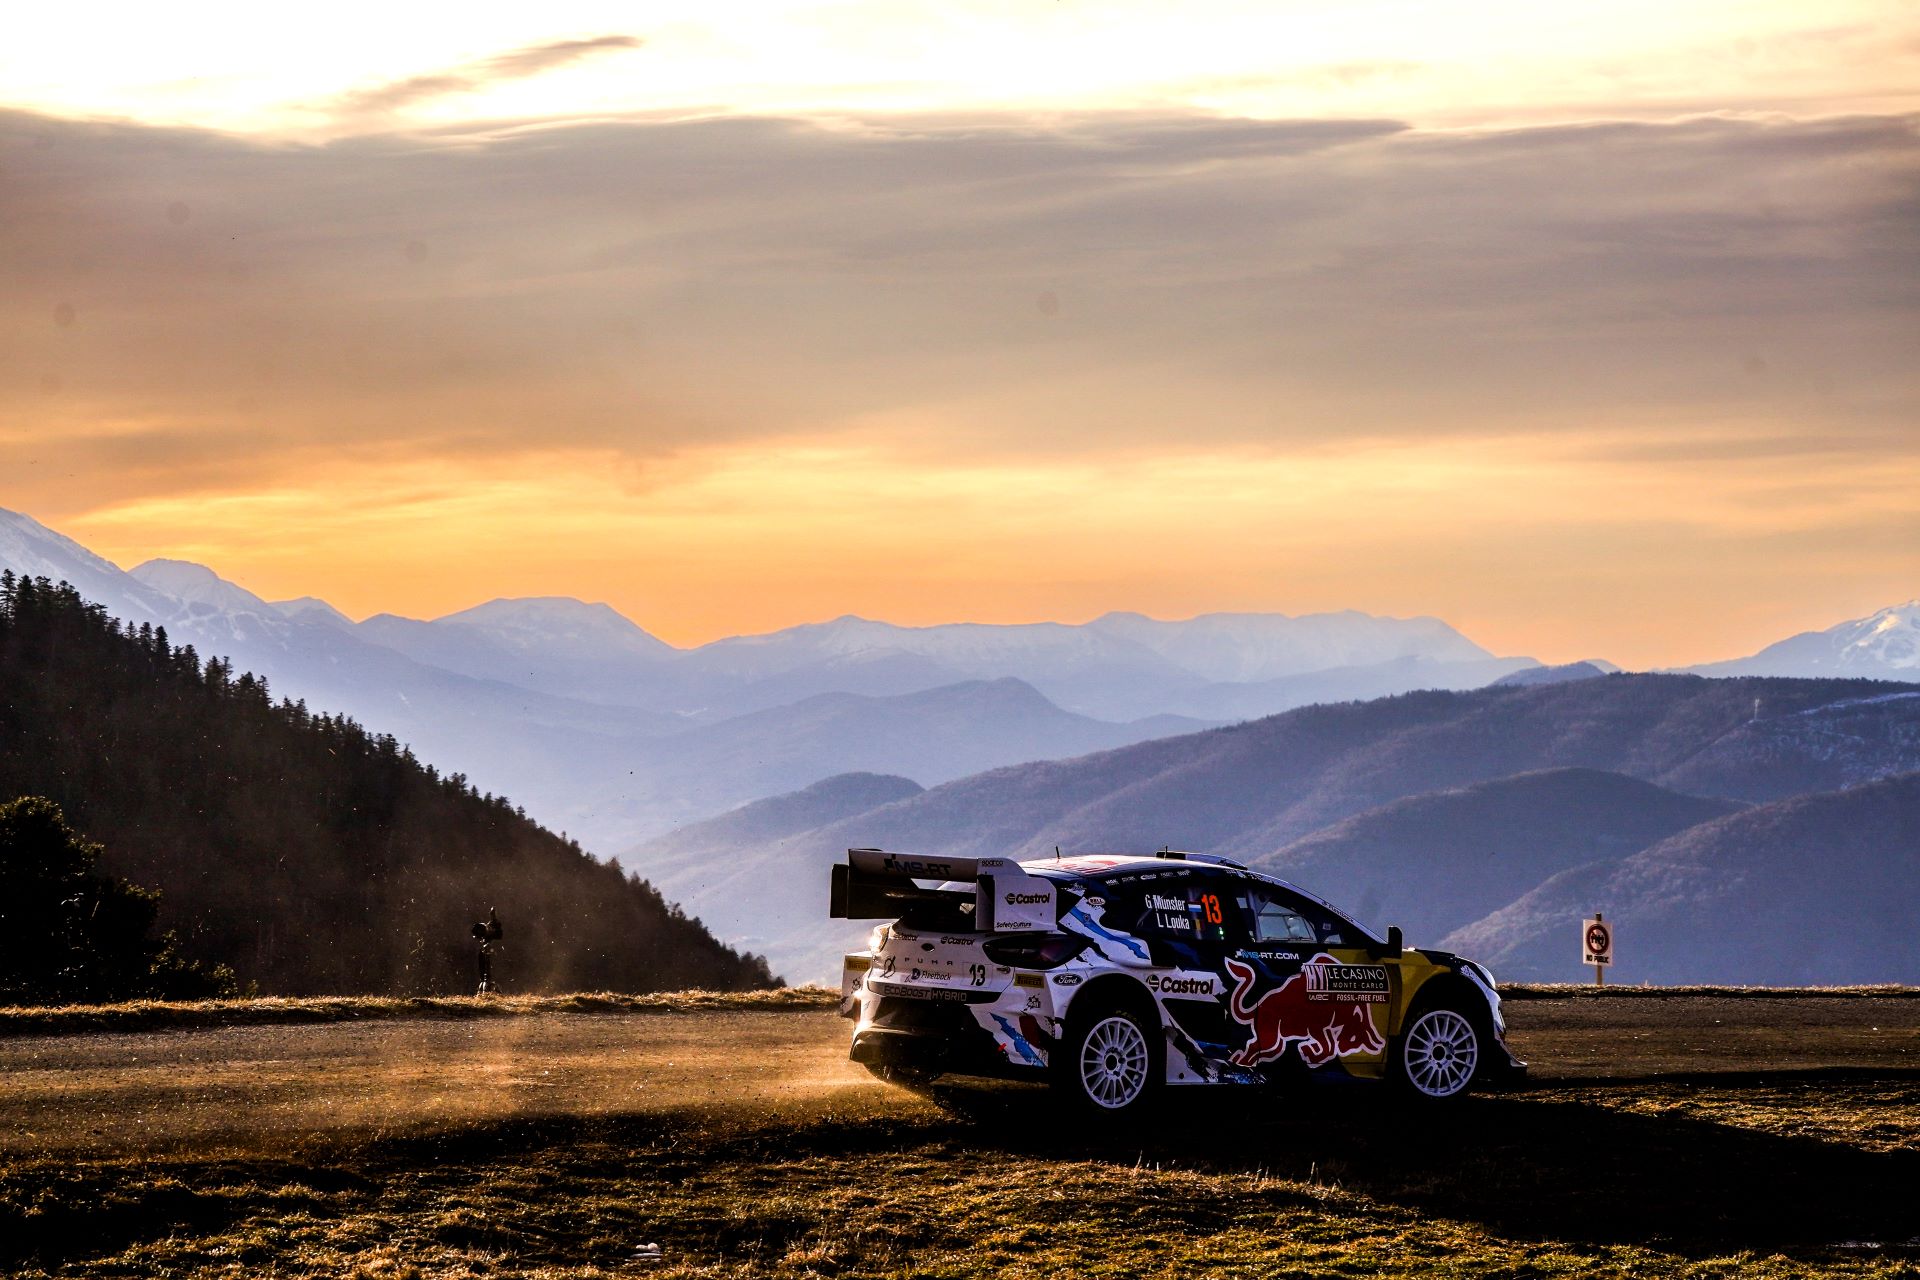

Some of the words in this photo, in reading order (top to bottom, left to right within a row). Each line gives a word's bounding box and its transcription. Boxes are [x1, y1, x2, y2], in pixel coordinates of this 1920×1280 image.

[1016, 893, 1051, 904] Castrol
[1144, 894, 1152, 909] G
[1201, 894, 1222, 924] 13
[1156, 912, 1164, 928] L
[1164, 913, 1190, 930] Louka
[947, 937, 975, 946] Castrol
[904, 957, 953, 966] PUMA
[969, 963, 986, 986] 13
[1058, 975, 1078, 984] Ford
[1327, 967, 1341, 979] LE
[1341, 968, 1385, 980] CASINO
[1160, 976, 1214, 995] Castrol
[931, 987, 967, 1002] HYBRID
[1336, 994, 1372, 1002] FOSSIL-FREE
[1372, 994, 1386, 1002] FUEL
